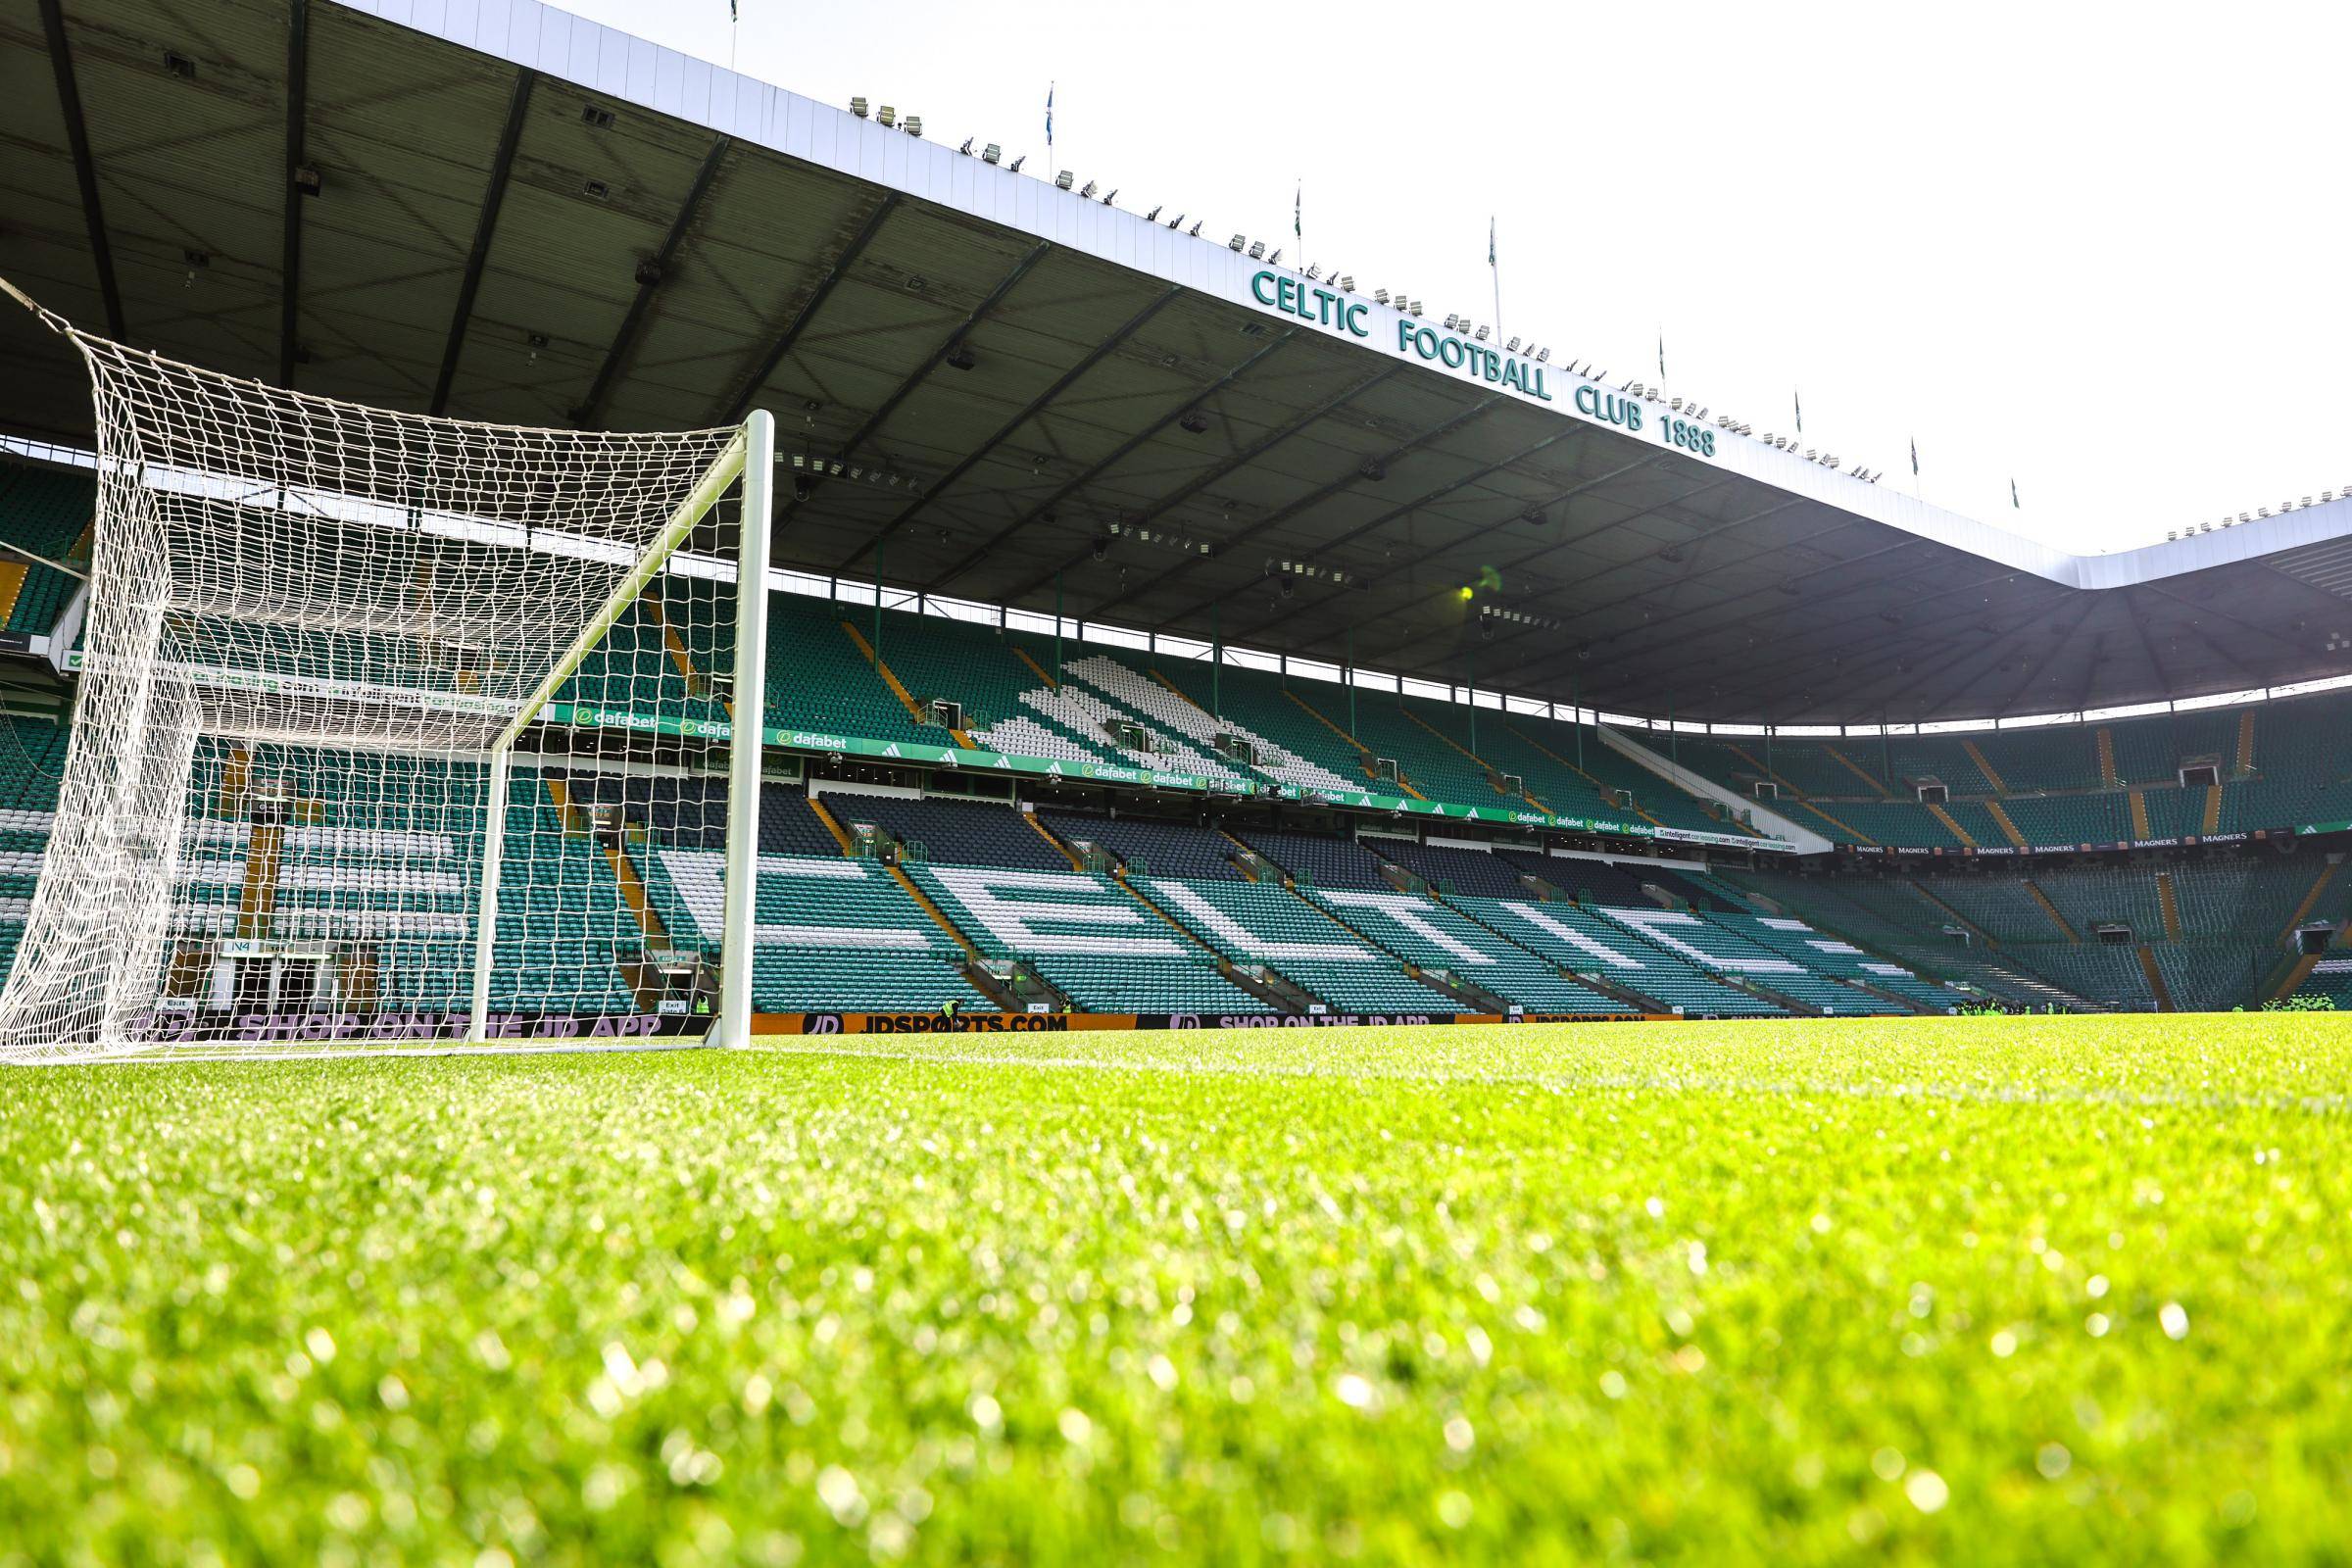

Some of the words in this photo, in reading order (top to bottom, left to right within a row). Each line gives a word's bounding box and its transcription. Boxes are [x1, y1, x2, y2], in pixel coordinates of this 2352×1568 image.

[1252, 270, 1369, 337] CELTIC
[1399, 318, 1552, 401] FOOTBALL
[1576, 385, 1643, 431] CLUB
[1664, 414, 1717, 458] 1888
[594, 710, 656, 728] dafabet
[697, 720, 730, 737] dafa
[793, 729, 847, 749] dafabet
[761, 765, 792, 776] afabet
[1095, 765, 1137, 781] dafabet
[1152, 771, 1193, 787] dafabet
[1517, 812, 1545, 824] dafabet
[1556, 817, 1584, 828] dafabet
[1593, 821, 1620, 832] dafabet
[1630, 825, 1655, 836] dafabet
[2134, 838, 2178, 849] MAGNERS
[2202, 832, 2248, 844] MAGNERS
[1856, 845, 1884, 854] MAGNERS
[1977, 847, 2014, 856] MAGNERS
[2034, 844, 2075, 854] MAGNERS
[236, 1013, 360, 1041] SHOP
[372, 1013, 434, 1039] ON
[534, 1014, 579, 1038] JD
[591, 1015, 662, 1037] APP
[808, 1014, 840, 1035] JD
[858, 1014, 1068, 1034] JDSPORTS.COM
[1219, 1015, 1279, 1029] SHOP
